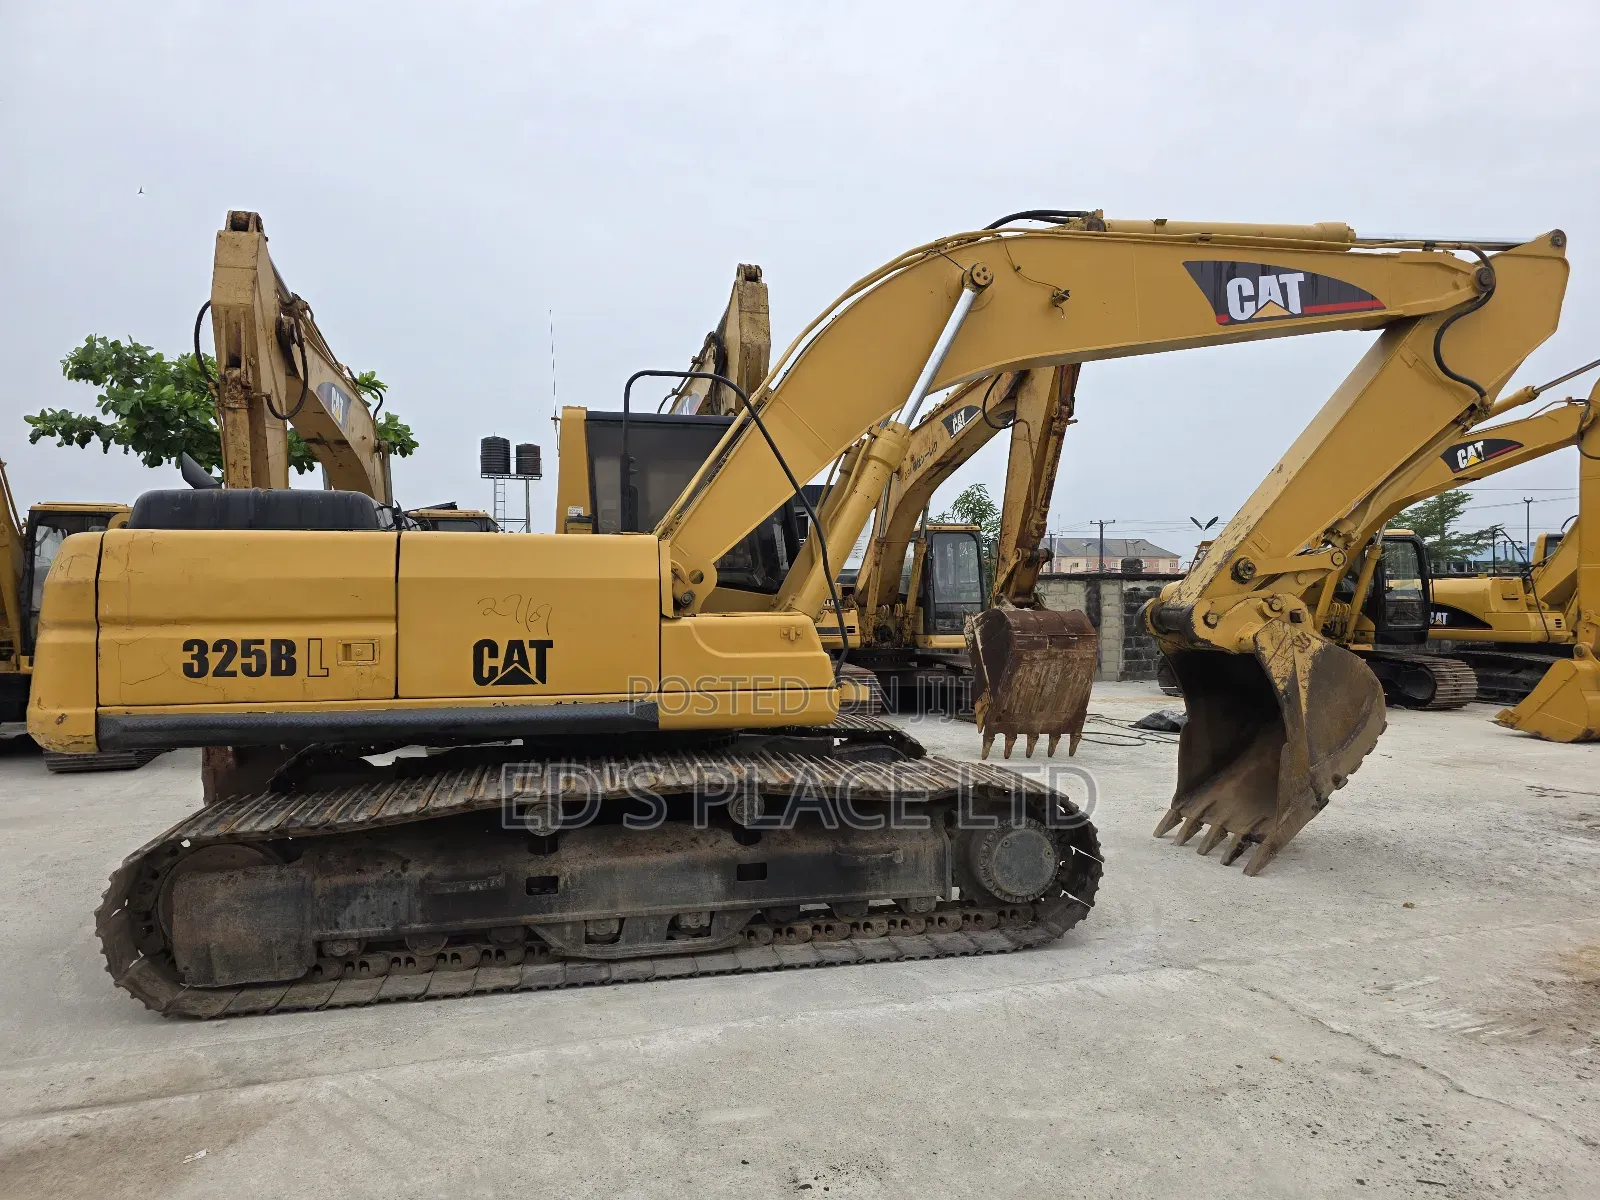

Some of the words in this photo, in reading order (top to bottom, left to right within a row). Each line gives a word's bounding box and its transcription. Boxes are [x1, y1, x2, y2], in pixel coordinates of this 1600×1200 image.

[1226, 272, 1305, 321] CAT
[331, 386, 344, 425] CAT
[952, 408, 966, 435] CAT
[1456, 440, 1485, 469] CAT
[182, 638, 297, 679] 325B
[307, 637, 330, 678] L
[472, 638, 554, 687] CAT
